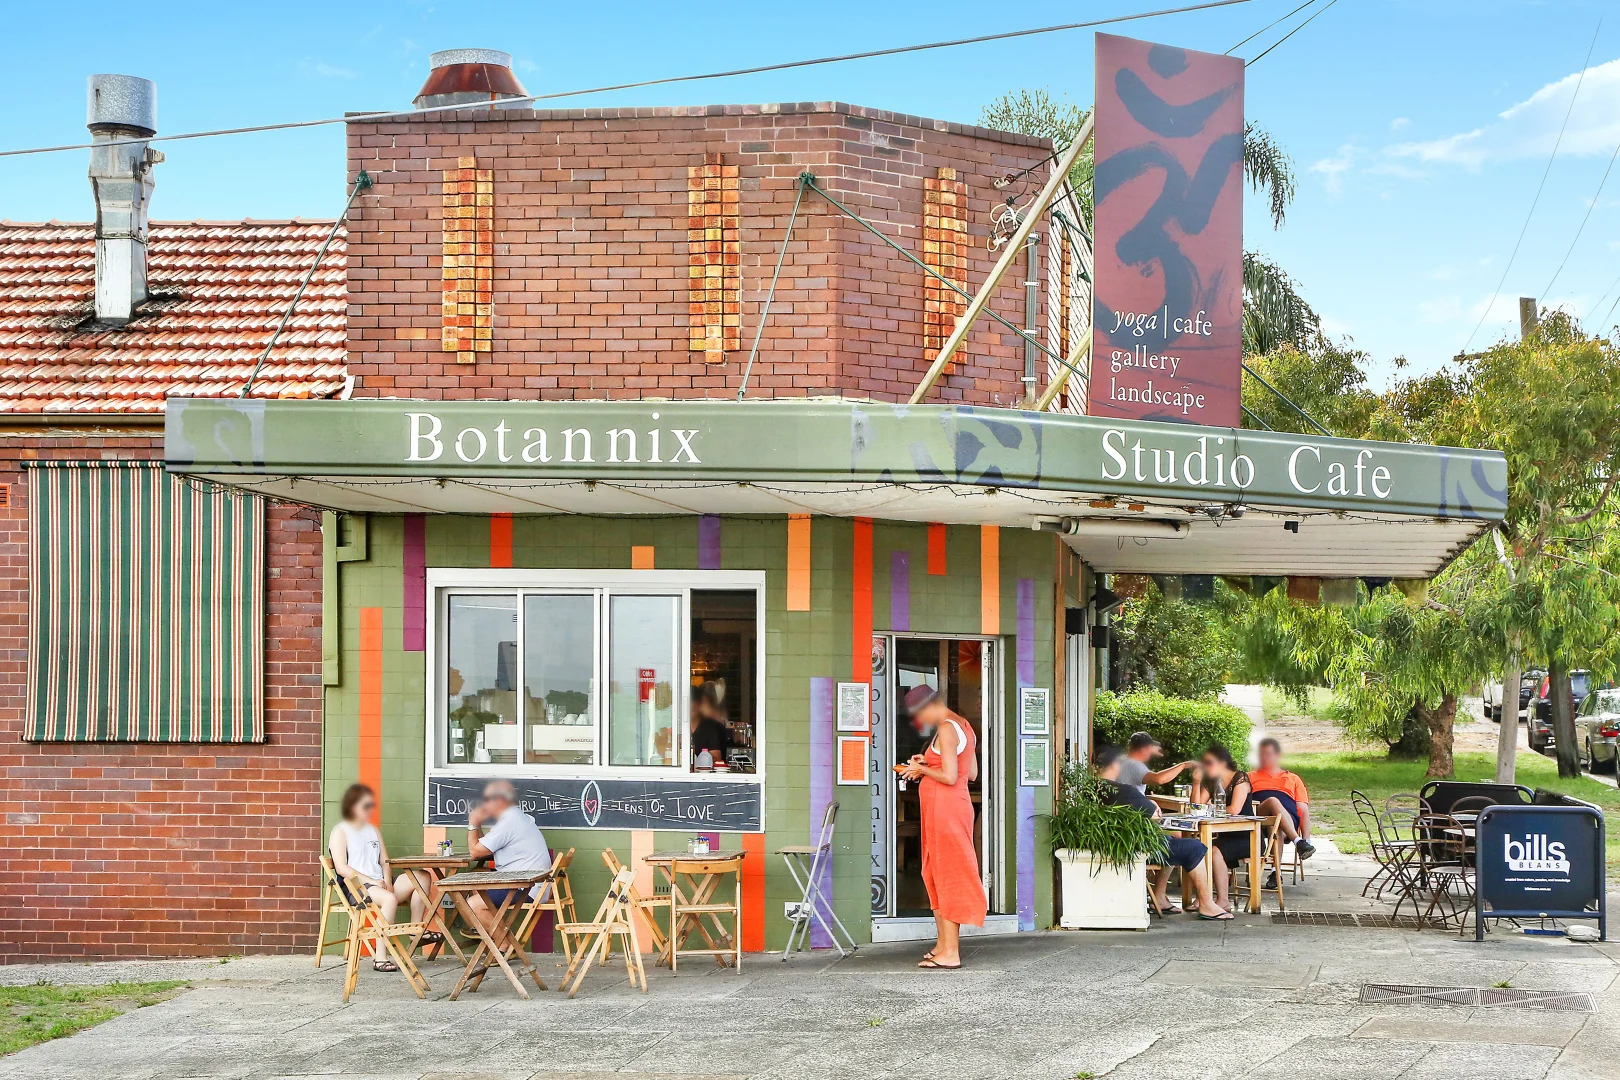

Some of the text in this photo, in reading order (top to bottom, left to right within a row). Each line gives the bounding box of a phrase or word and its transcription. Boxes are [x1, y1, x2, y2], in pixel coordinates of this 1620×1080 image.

[1110, 309, 1213, 337] yoga cafe
[1110, 344, 1181, 378] gallery
[1109, 376, 1205, 415] landscape
[403, 411, 702, 464] Botannix
[1101, 429, 1392, 500] Studio Cafe
[517, 799, 536, 814] HRU
[540, 795, 562, 811] THE
[650, 799, 666, 814] OF
[675, 798, 715, 821] LOVE
[1504, 833, 1567, 863] bills
